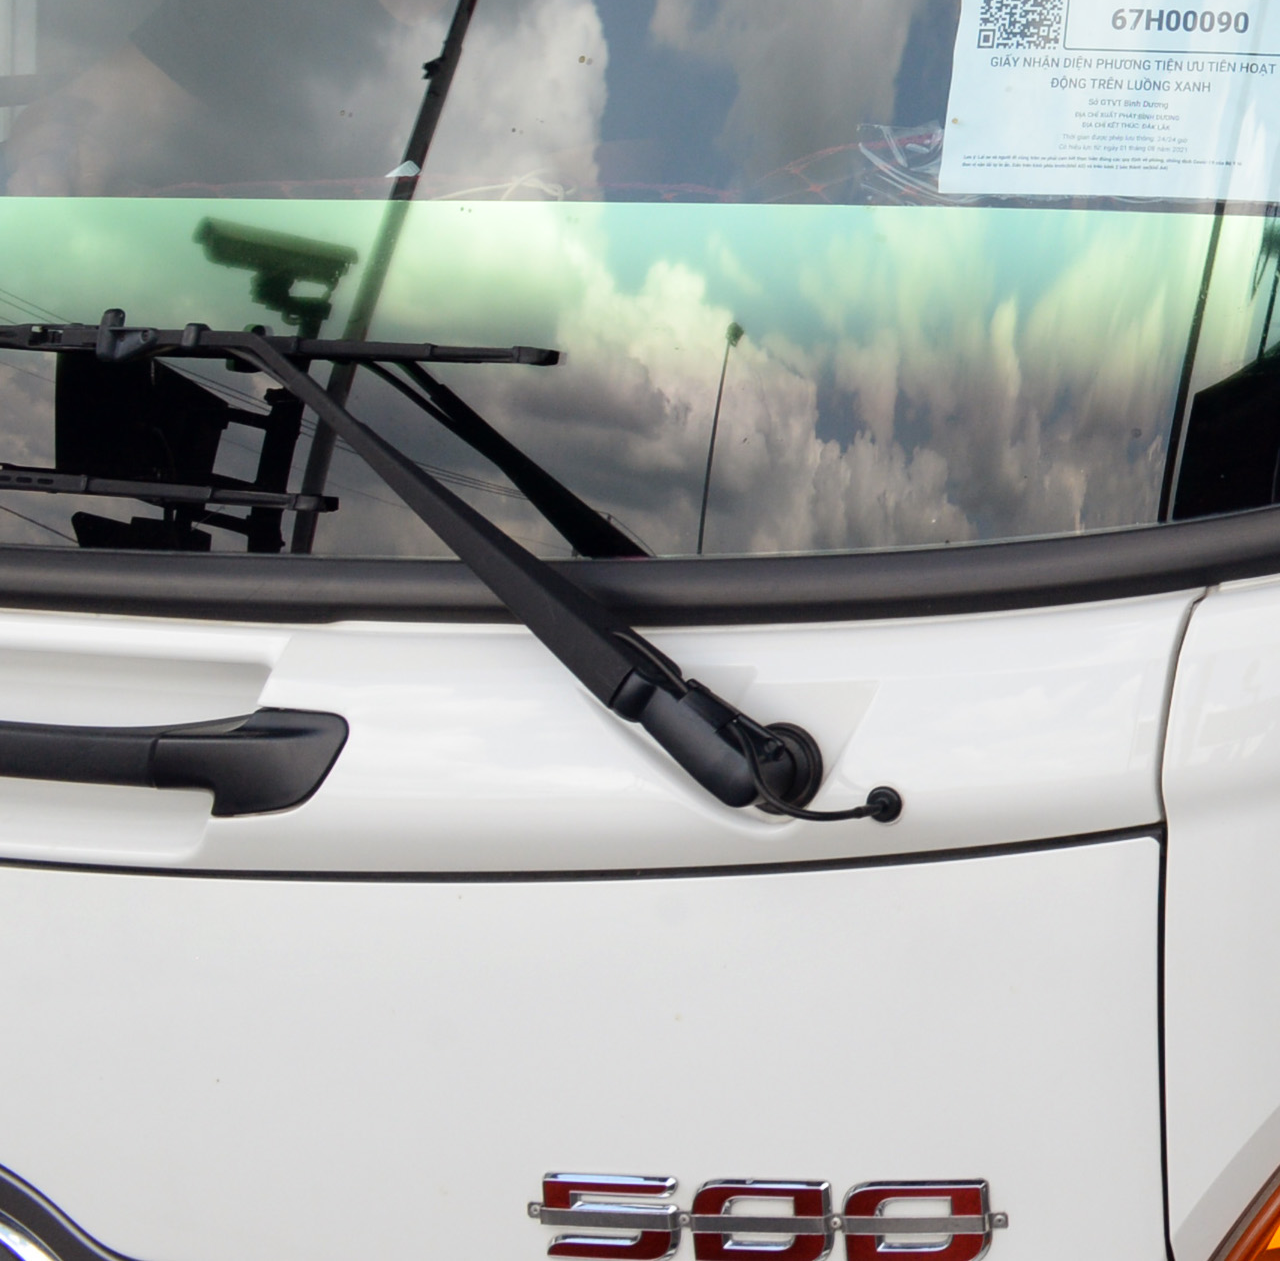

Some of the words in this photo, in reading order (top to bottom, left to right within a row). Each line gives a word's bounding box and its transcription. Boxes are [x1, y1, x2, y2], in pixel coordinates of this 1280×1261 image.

[1111, 8, 1250, 34] 67H00090
[990, 53, 1020, 68] GIẤY
[1022, 54, 1060, 70] NHẬN
[1063, 55, 1093, 71] DIỆN
[1096, 57, 1151, 71] PHƯƠNG
[1155, 58, 1183, 74] TIỆN
[1186, 60, 1205, 73] ƯU
[1208, 59, 1237, 73] TIÊN
[1240, 62, 1277, 76] HOẠT
[1050, 76, 1087, 91] ĐỘNG
[1090, 76, 1124, 91] TRÊN
[1127, 77, 1171, 92] LUỒNG
[1174, 80, 1211, 93] XANH
[1100, 98, 1122, 107] GTVT
[1124, 99, 1141, 108] Bình
[1142, 101, 1169, 111] Dương
[542, 1171, 994, 1261] 500
